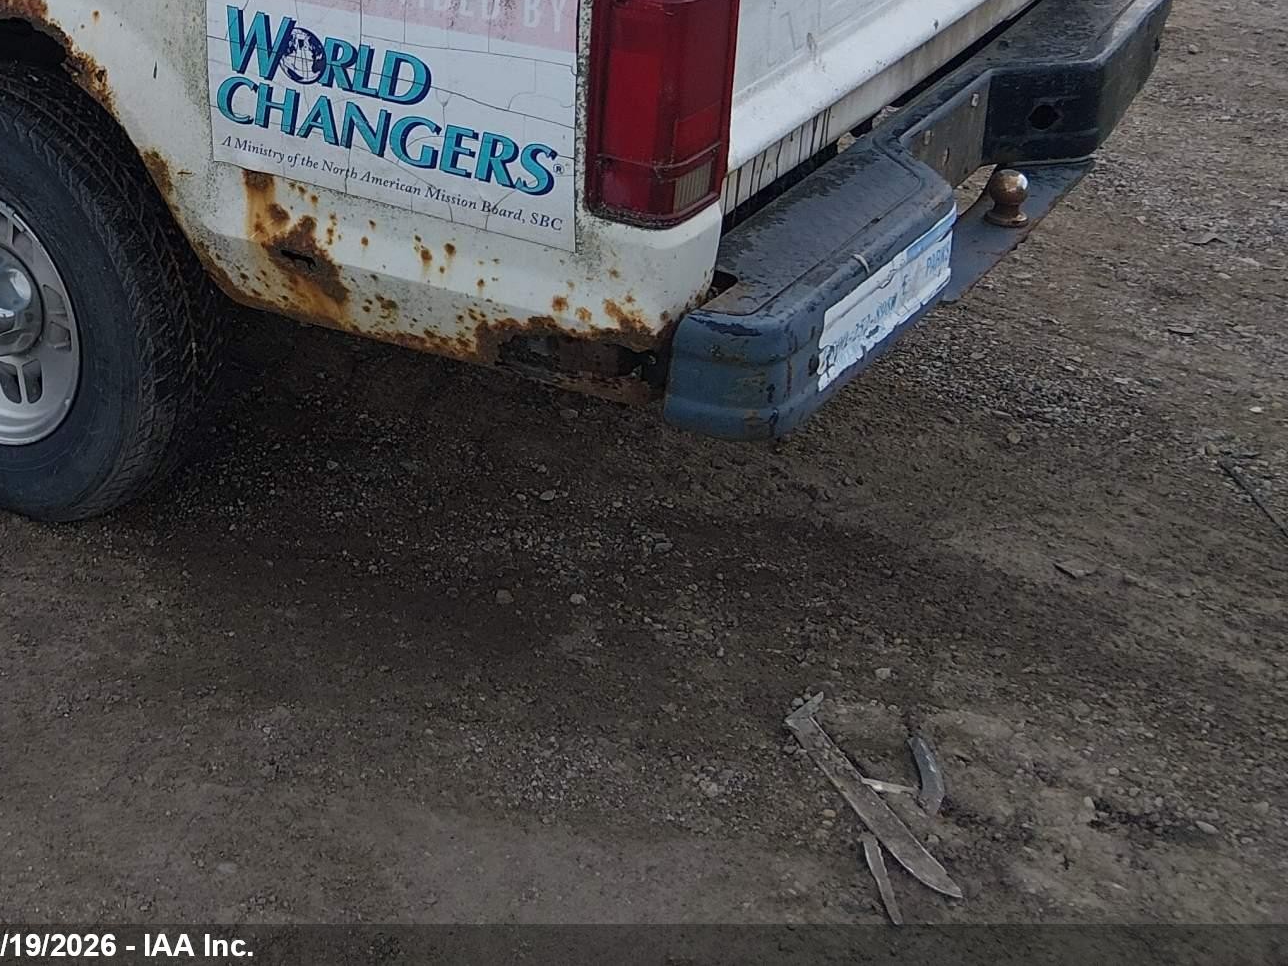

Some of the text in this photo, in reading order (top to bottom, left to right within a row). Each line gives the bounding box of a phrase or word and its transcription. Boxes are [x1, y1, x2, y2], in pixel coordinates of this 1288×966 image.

[226, 5, 432, 105] WORLD
[221, 135, 563, 231] A Ministry of the North American Mission Board, SBC
